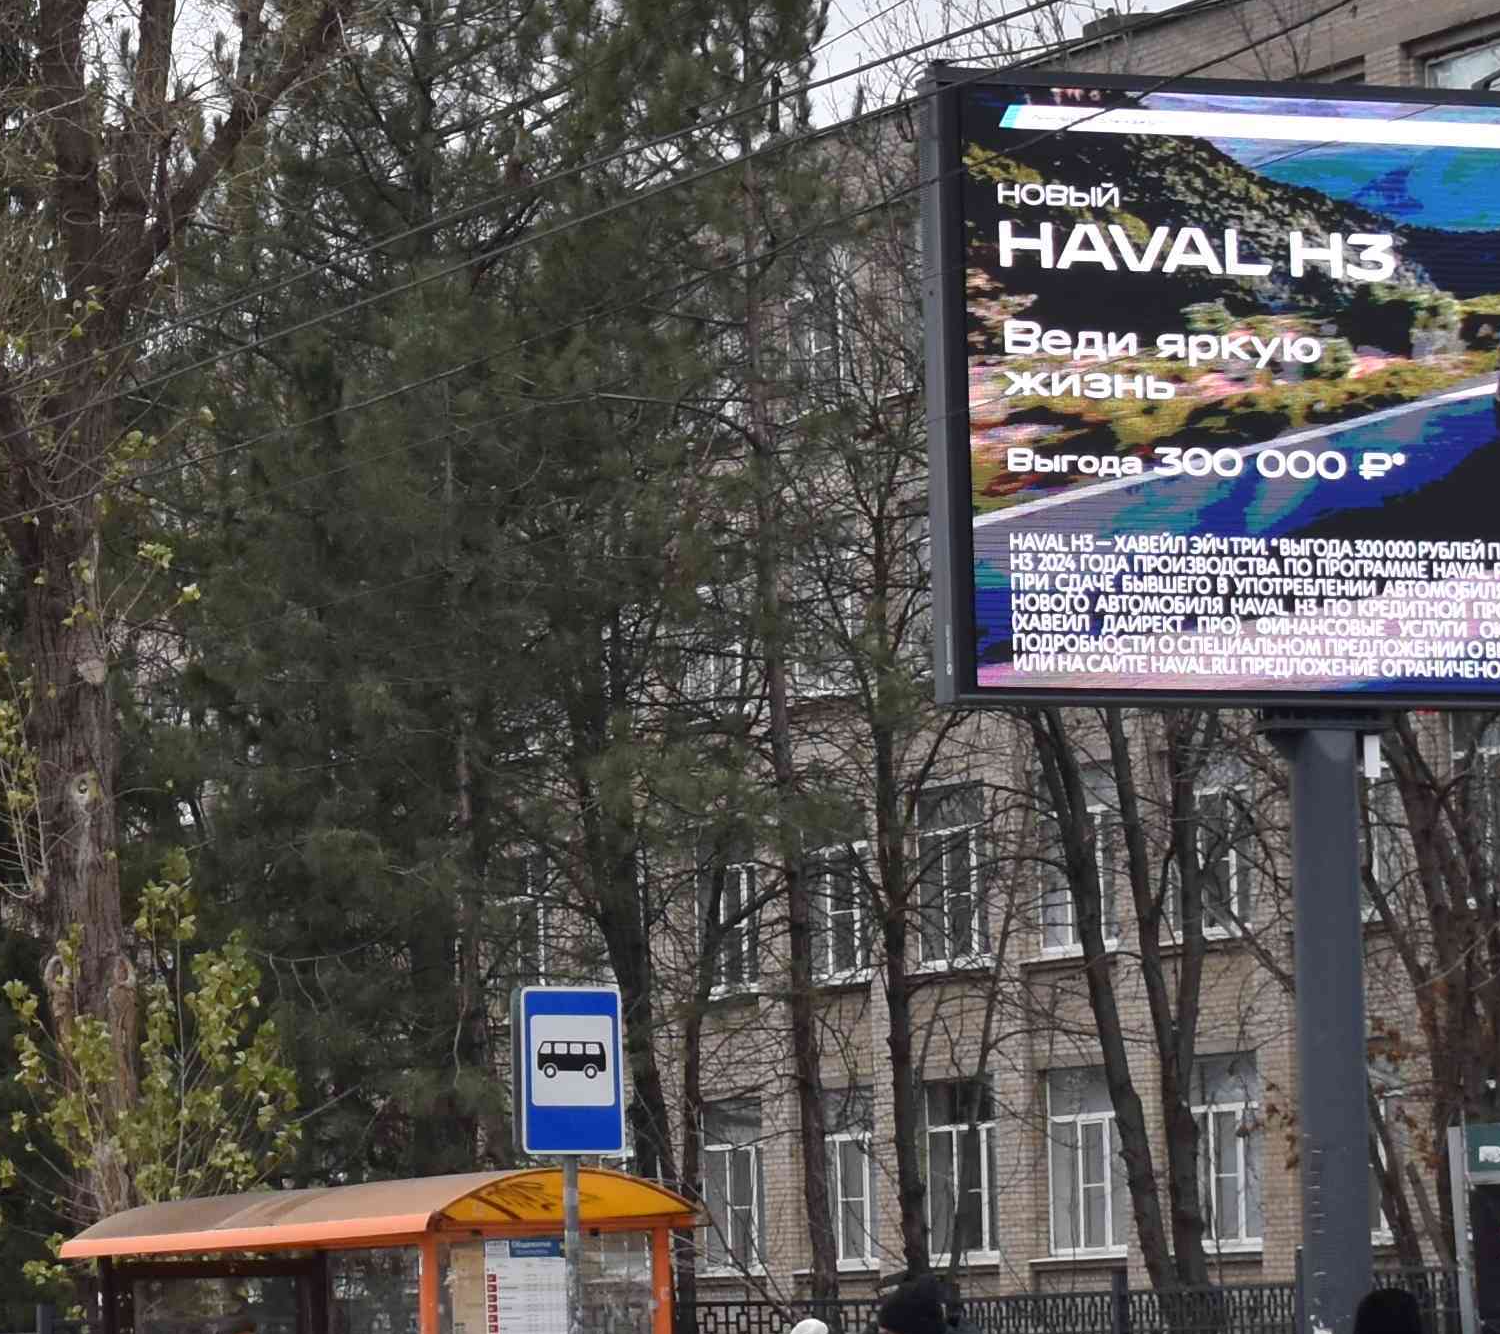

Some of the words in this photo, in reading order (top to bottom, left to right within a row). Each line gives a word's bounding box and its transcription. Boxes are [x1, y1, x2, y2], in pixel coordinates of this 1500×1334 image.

[998, 220, 1272, 276] HAVAL
[1289, 231, 1396, 281] H3
[1003, 319, 1138, 361] Веди
[1156, 332, 1321, 368] яркую
[1003, 371, 1175, 400] жизнь
[1006, 447, 1143, 477] Выгода
[1153, 447, 1243, 477] 300
[1256, 449, 1346, 479] 000
[1009, 533, 1070, 553] HAVAL
[1114, 531, 1186, 555] ХАВЕЙЛ
[1189, 533, 1228, 556] ЭЙЧ
[1354, 541, 1383, 559] 300
[1384, 541, 1416, 559] 000
[1418, 538, 1484, 561] РУБЛЕЙ
[1038, 554, 1076, 572] 2024
[1080, 555, 1130, 576] ГОДА
[1134, 556, 1280, 579] ПРОИЗВОДСТВА
[1285, 559, 1312, 576] ПО
[1317, 560, 1428, 578] ПРОГРАММЕ
[1433, 562, 1492, 579] HAVAL
[1010, 573, 1049, 591] ПРИ
[1055, 574, 1114, 595] СДАЧЕ
[1122, 575, 1211, 594] БЫВШЕГО
[1216, 577, 1228, 594] В
[1233, 577, 1377, 597] УПОТРЕБЛЕНИИ
[1011, 595, 1089, 612] НОВОГО
[1095, 596, 1223, 615] АВТОМОБИЛЯ
[1231, 598, 1289, 616] HAVAL
[1323, 600, 1352, 617] ПО
[1357, 596, 1466, 622] КРЕДИТНОЙ
[1012, 610, 1090, 636] (ХАВЕЙЛ
[1101, 613, 1184, 637] ДАЙРЕКТ
[1256, 619, 1385, 637] ФИНАНСОВЫЕ
[1399, 621, 1468, 639] УСЛУГИ
[1012, 635, 1154, 657] ПОДРОБНОСТИ
[1159, 637, 1175, 654] О
[1177, 637, 1321, 659] СПЕЦИАЛЬНОМ
[1325, 639, 1464, 661] ПРЕДЛОЖЕНИИ
[1467, 641, 1482, 658] О
[1013, 655, 1056, 672] ИЛИ
[1058, 655, 1086, 672] НА
[1086, 652, 1148, 673] САЙТЕ
[1241, 658, 1381, 680] ПРЕДЛОЖЕНИЕ
